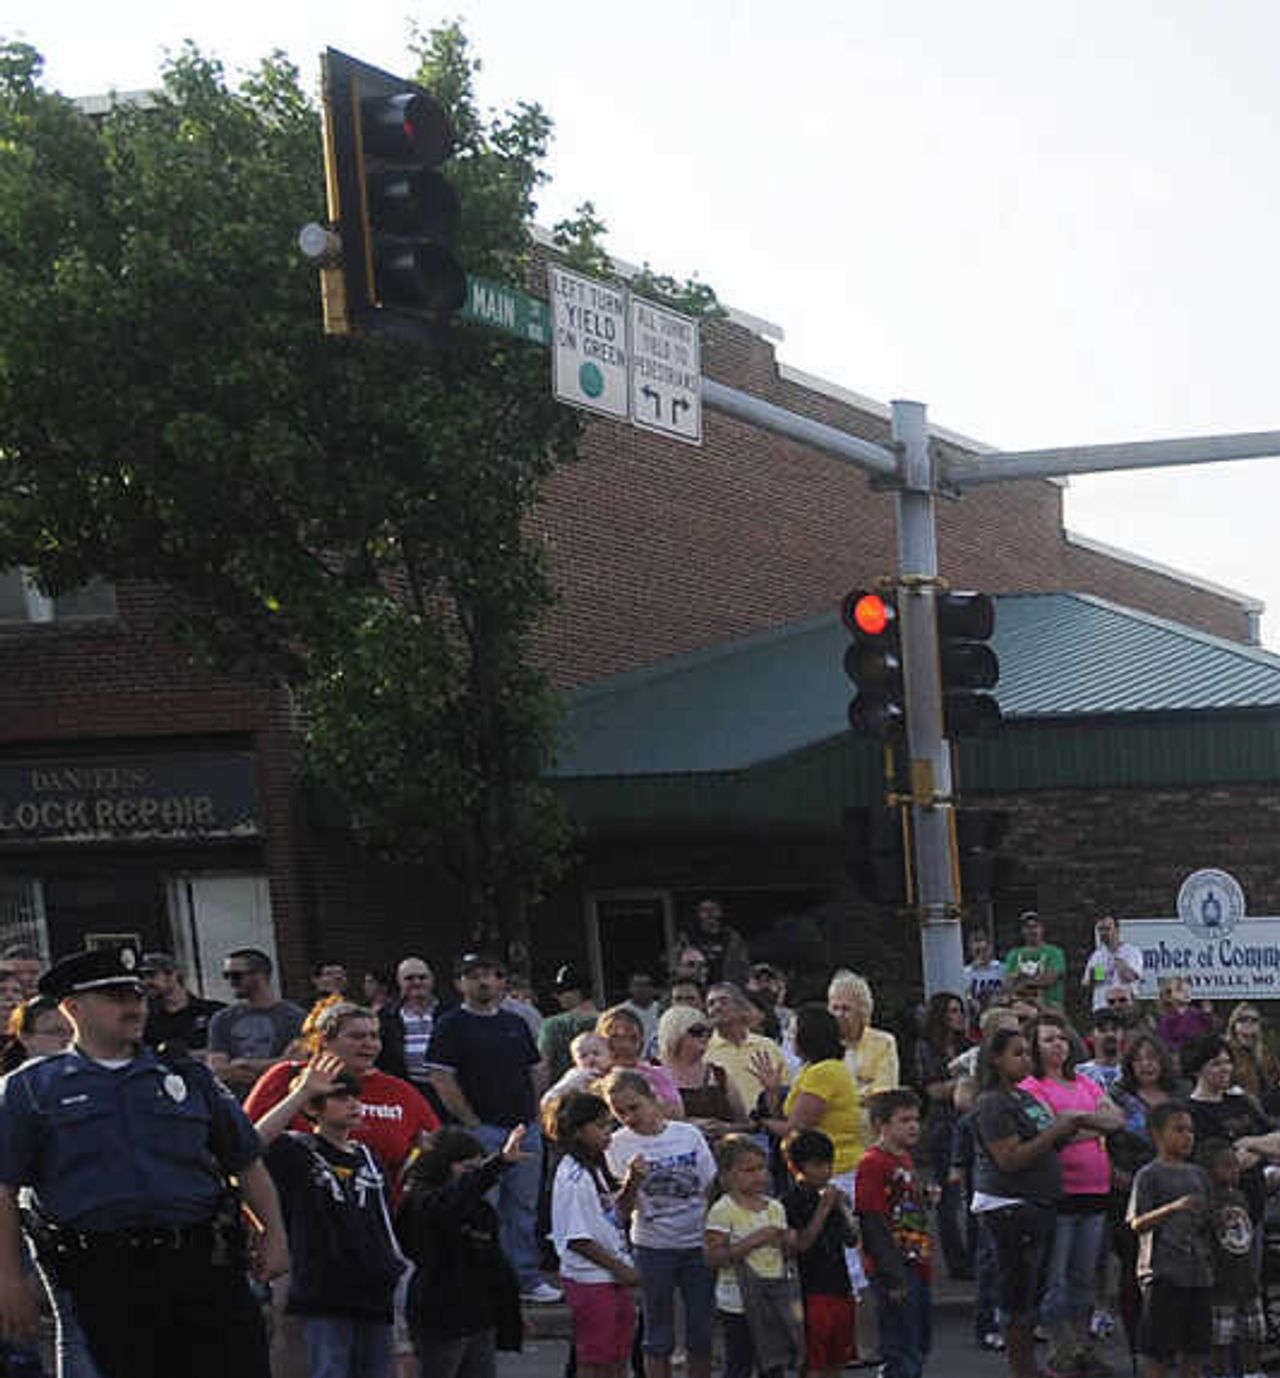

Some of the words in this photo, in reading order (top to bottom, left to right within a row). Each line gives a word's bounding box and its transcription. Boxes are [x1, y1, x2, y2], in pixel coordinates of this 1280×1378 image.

[473, 282, 515, 328] MAIN
[554, 273, 585, 300] LEFT
[589, 286, 622, 315] TURN
[566, 303, 615, 341] YIELD
[583, 337, 625, 367] GREEN
[95, 796, 215, 828] REPAIR
